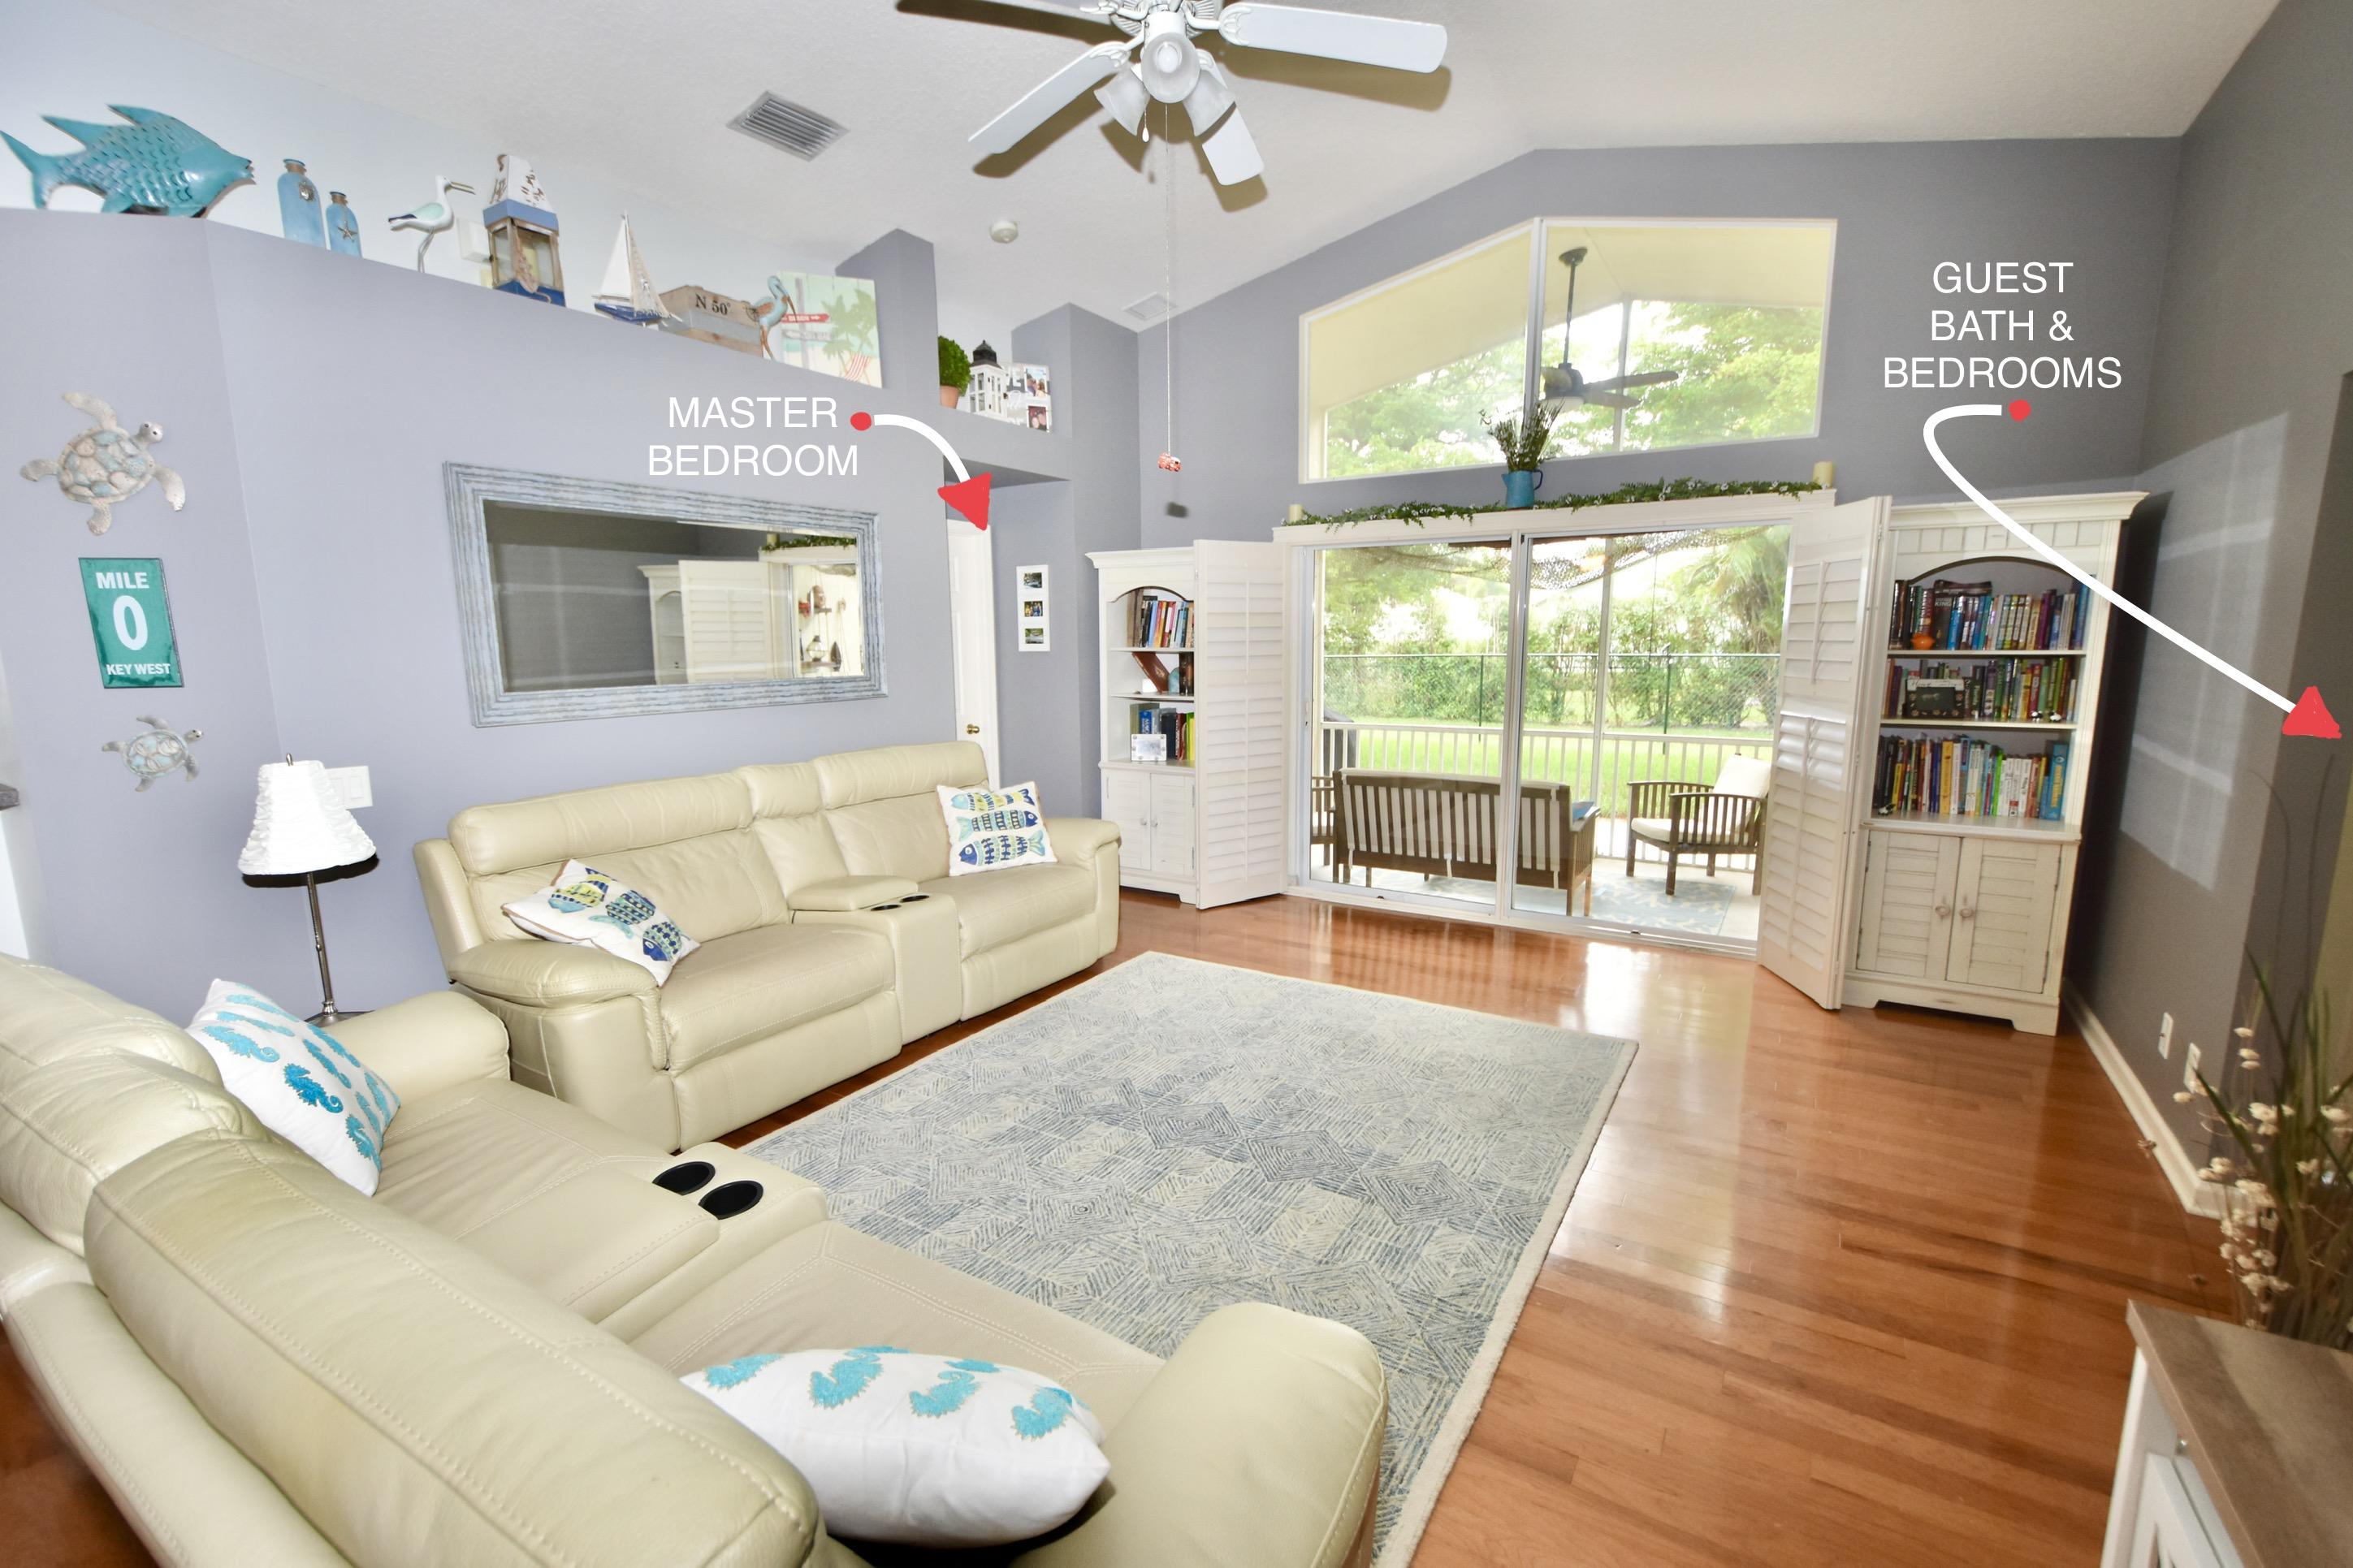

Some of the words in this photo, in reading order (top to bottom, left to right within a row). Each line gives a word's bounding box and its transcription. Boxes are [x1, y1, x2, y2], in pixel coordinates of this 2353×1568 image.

[695, 293, 707, 309] N
[96, 572, 149, 590] MILE
[113, 595, 148, 650] 0
[106, 663, 132, 675] KEY
[133, 663, 171, 675] WEST
